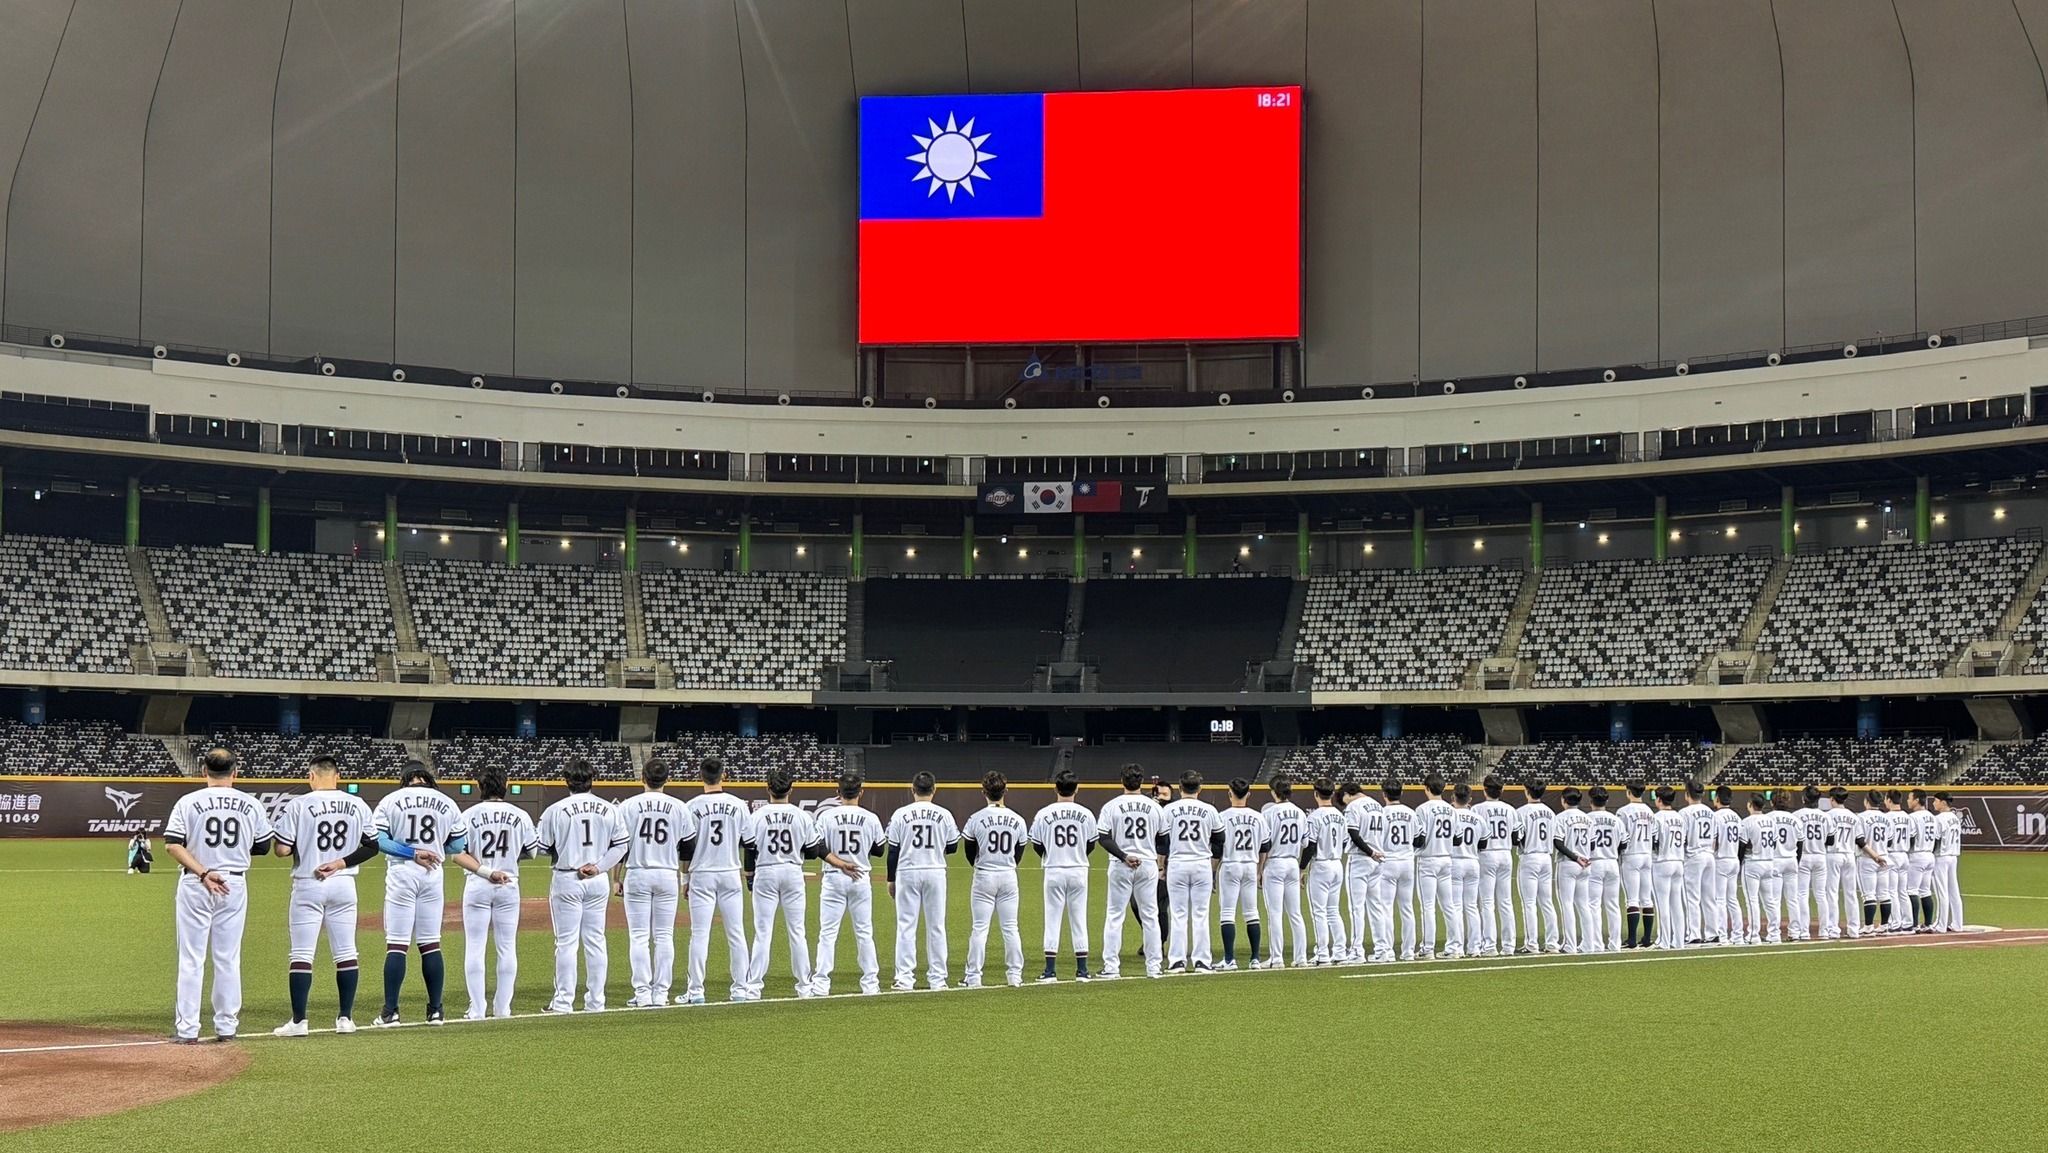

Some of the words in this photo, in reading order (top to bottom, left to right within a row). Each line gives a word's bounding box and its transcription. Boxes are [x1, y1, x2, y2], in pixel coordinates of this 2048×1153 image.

[1258, 92, 1290, 108] 18:21
[1210, 720, 1234, 732] 0:18
[193, 797, 252, 816] H.J.TSENG
[308, 800, 358, 818] C.J.SUNG
[395, 796, 450, 815] Y.C.CHANG
[563, 802, 608, 818] T.H.CHEN
[639, 801, 672, 814] J.H.LIU
[693, 803, 738, 820] W.J.CHEN
[88, 819, 162, 832] TAIWOLF
[471, 812, 521, 829] C.H.CHEN
[903, 809, 944, 824] C.H.CHEN
[1370, 815, 1383, 835] 44
[205, 816, 240, 848] 99
[317, 820, 348, 852] 88
[405, 815, 435, 844] 18
[582, 820, 593, 846] 1
[639, 818, 669, 845] 46
[710, 820, 723, 846] 3
[912, 825, 935, 849] 31
[1054, 824, 1078, 848] 66
[1124, 816, 1147, 839] 28
[1178, 820, 1200, 841] 23
[1280, 823, 1298, 845] 20
[1391, 825, 1409, 845] 81
[1436, 819, 1452, 838] 29
[1490, 820, 1507, 839] 16
[1539, 822, 1547, 841] 6
[1574, 828, 1587, 846] 73
[1637, 824, 1649, 842] 71
[1698, 822, 1711, 839] 12
[1727, 826, 1739, 843] 69
[1779, 828, 1787, 844] 9
[1807, 824, 1822, 840] 65
[1838, 827, 1851, 843] 77
[1873, 826, 1885, 842] 63
[1896, 828, 1906, 844] 74
[1925, 826, 1934, 842] 55
[482, 830, 509, 858] 24
[768, 829, 793, 856] 39
[838, 830, 861, 855] 15
[988, 830, 1012, 854] 90
[1235, 829, 1253, 851] 22
[1596, 829, 1612, 847] 25
[1670, 830, 1682, 848] 79
[1761, 831, 1774, 848] 58
